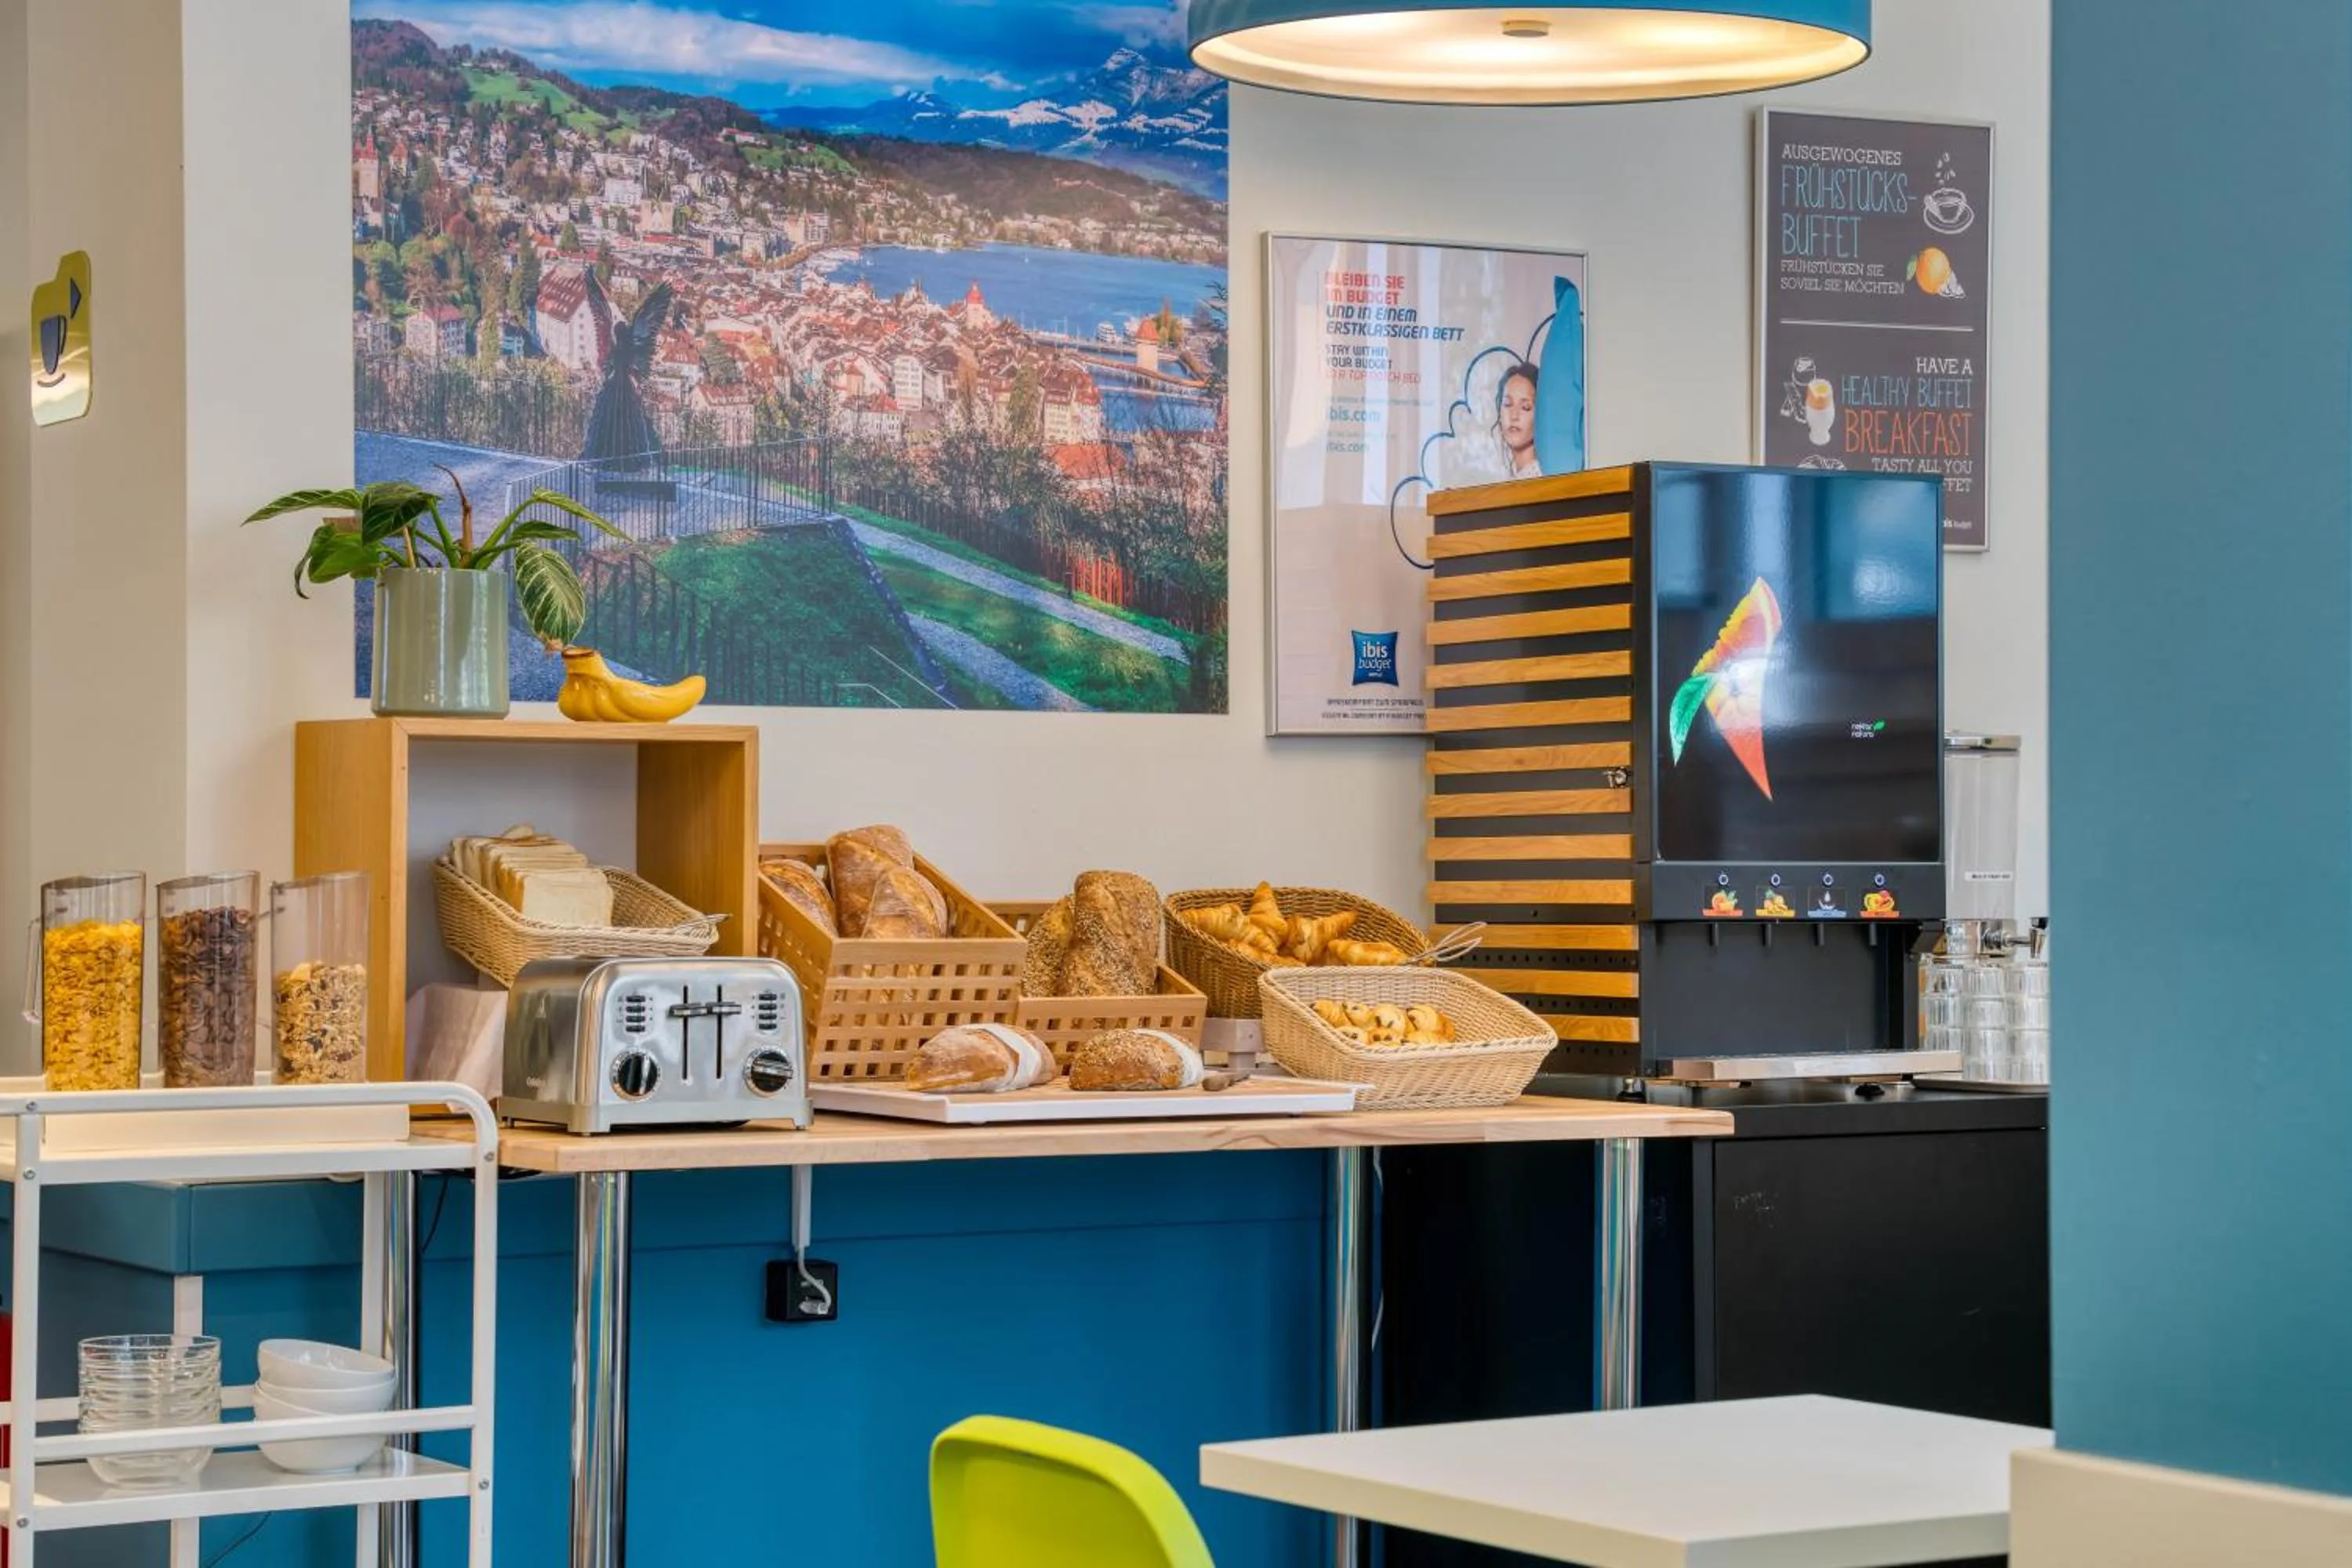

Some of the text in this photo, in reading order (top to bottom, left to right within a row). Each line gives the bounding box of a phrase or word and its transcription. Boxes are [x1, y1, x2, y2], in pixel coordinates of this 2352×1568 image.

[1781, 143, 1903, 166] AUSGEWOGENES
[1782, 212, 1862, 259] BUFFET
[1780, 258, 1885, 277] FRÜHSTÜCKEN SIE
[1385, 274, 1406, 289] SIE
[1780, 276, 1906, 295] SOVIEL SIE MÖCHTEN
[1346, 289, 1400, 305] BUDGET
[1326, 304, 1418, 323] UND IN EINEM
[1326, 321, 1465, 342] ERSTKLASSIGEN BETT
[1915, 357, 1973, 376] HAVE A
[1840, 375, 1973, 409] HEALTHY BUFFET
[1844, 408, 1973, 457] BREAKFAST
[1871, 457, 1973, 474] TASTY ALL YOU
[1943, 477, 1973, 492] FET
[1362, 640, 1388, 658] ibis
